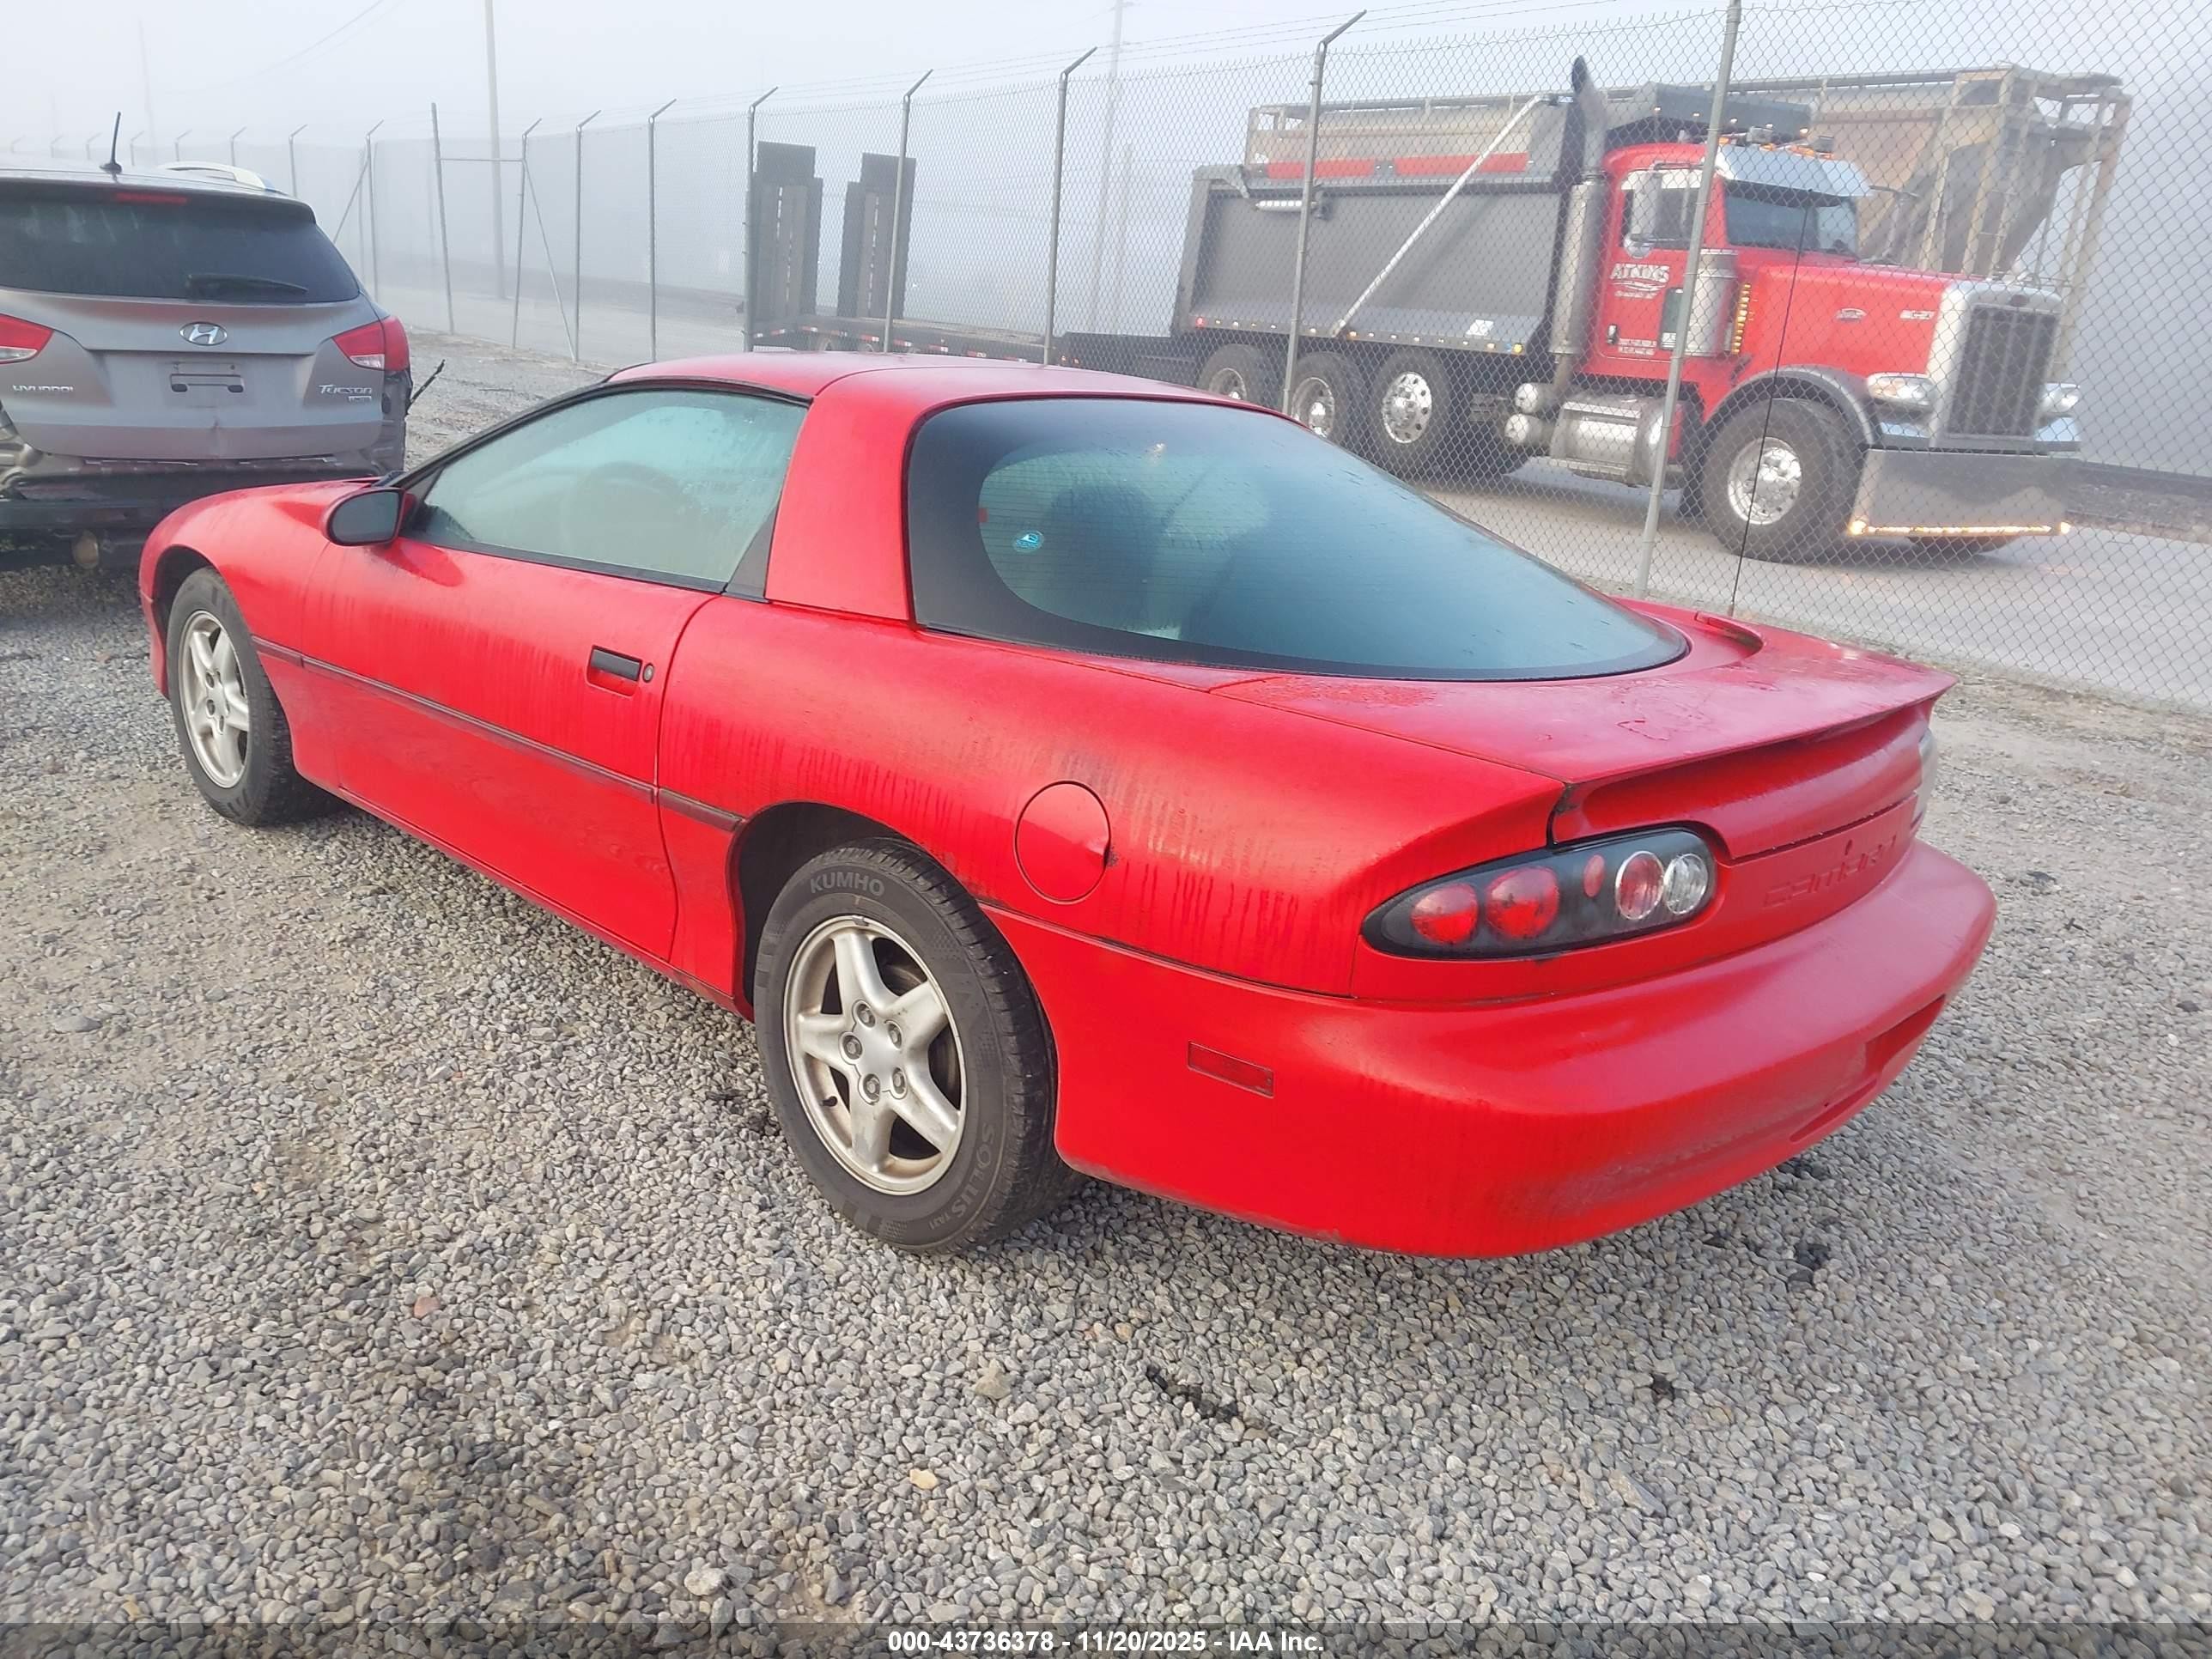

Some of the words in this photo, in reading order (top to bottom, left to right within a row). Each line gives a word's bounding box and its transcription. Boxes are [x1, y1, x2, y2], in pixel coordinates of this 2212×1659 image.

[12, 384, 74, 392] HYUNDAI
[810, 872, 884, 896] KUMHO
[951, 1121, 994, 1218] SOLUS
